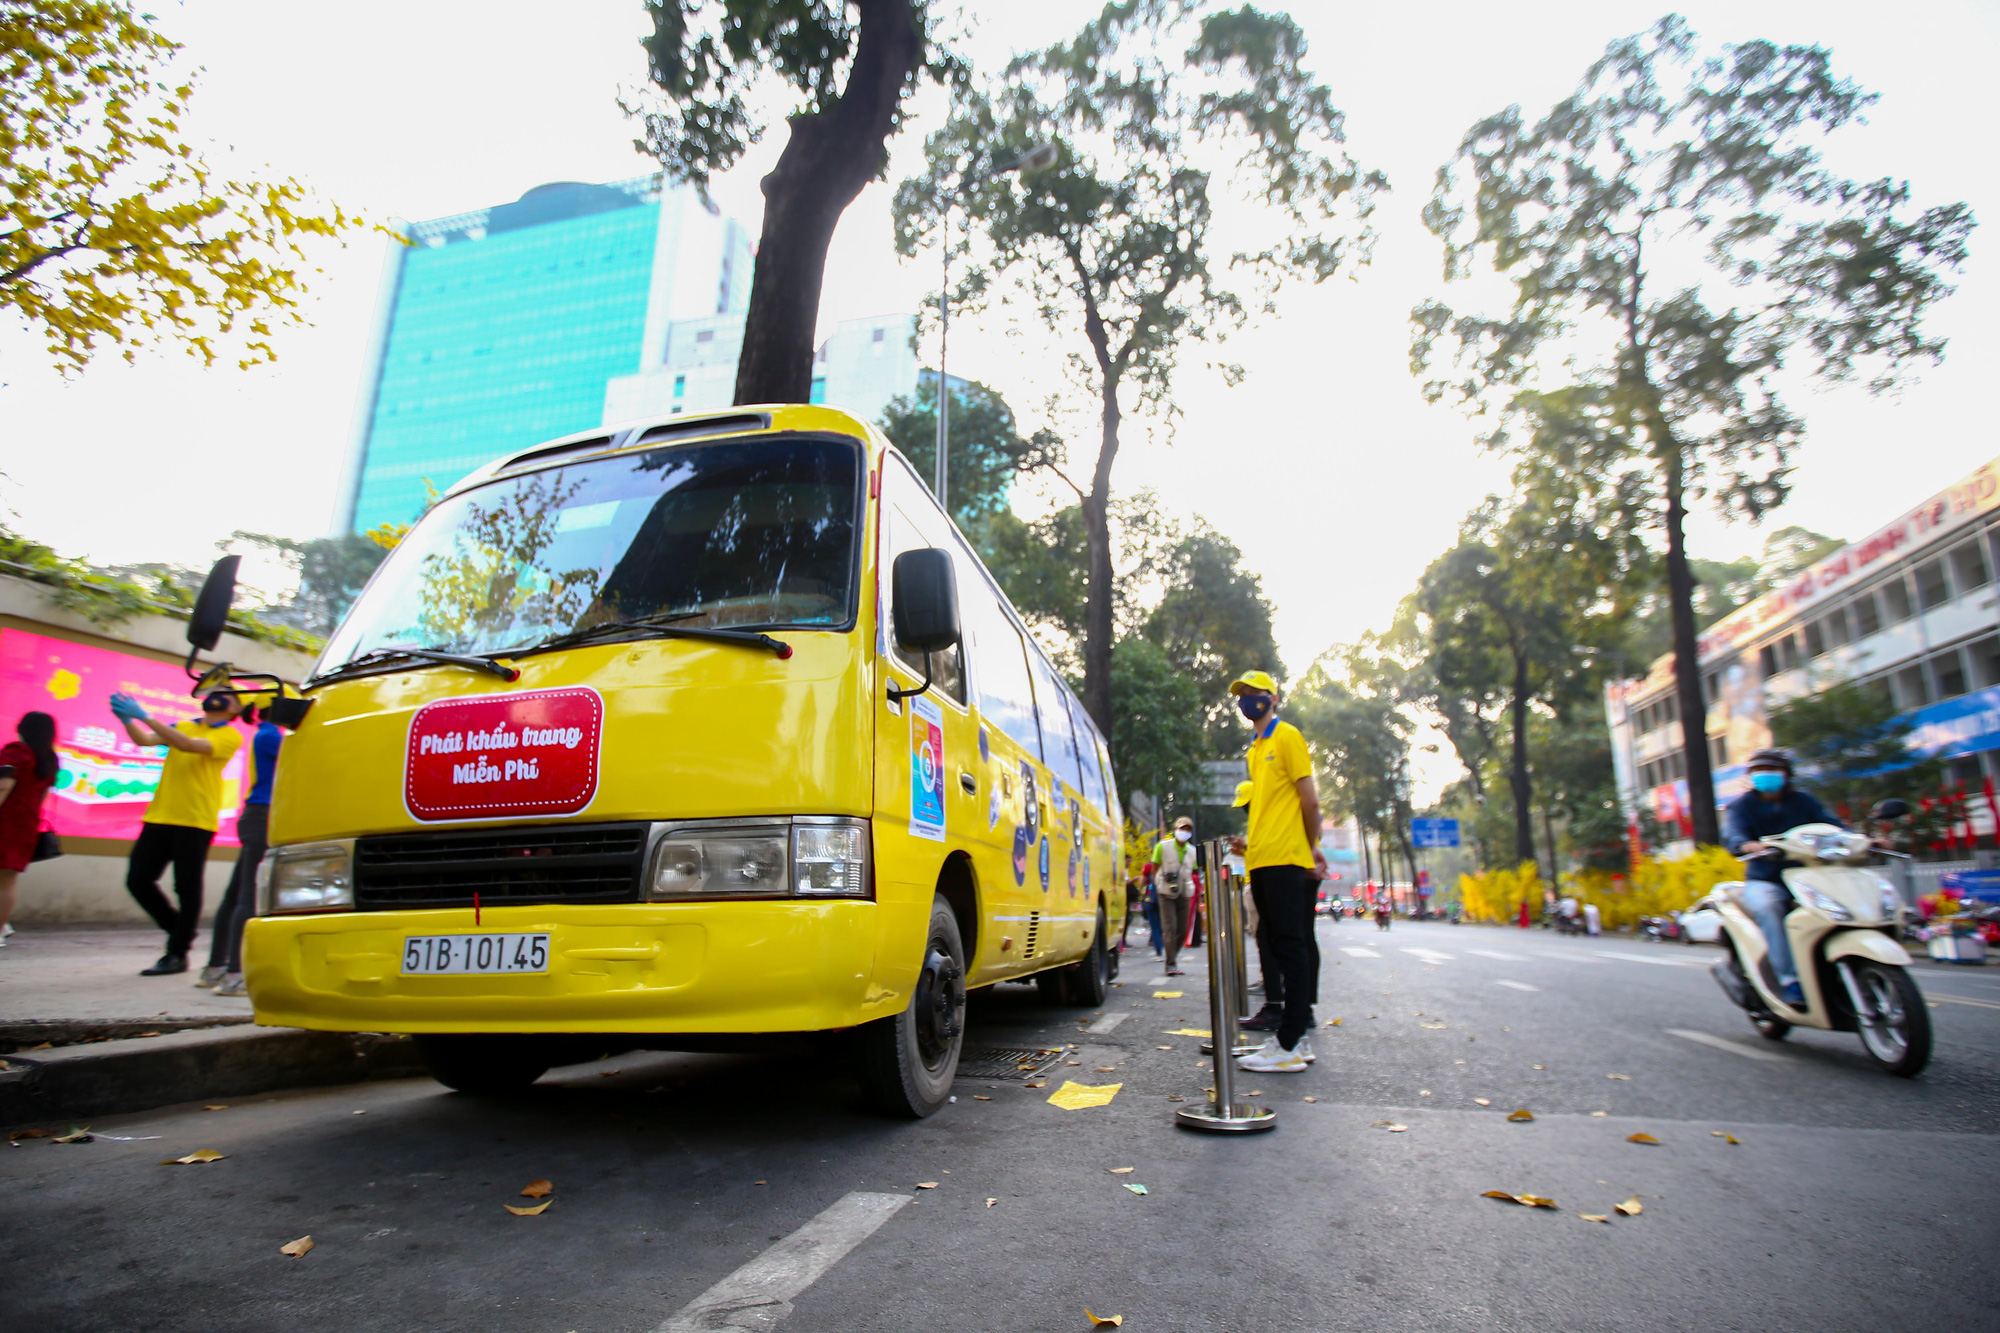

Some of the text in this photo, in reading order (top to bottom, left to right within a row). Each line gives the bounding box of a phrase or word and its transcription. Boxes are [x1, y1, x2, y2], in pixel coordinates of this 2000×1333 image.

[420, 721, 583, 755] Phát khẩu trang
[452, 754, 539, 784] Miễn Phí
[405, 936, 546, 972] 51B-101.45
